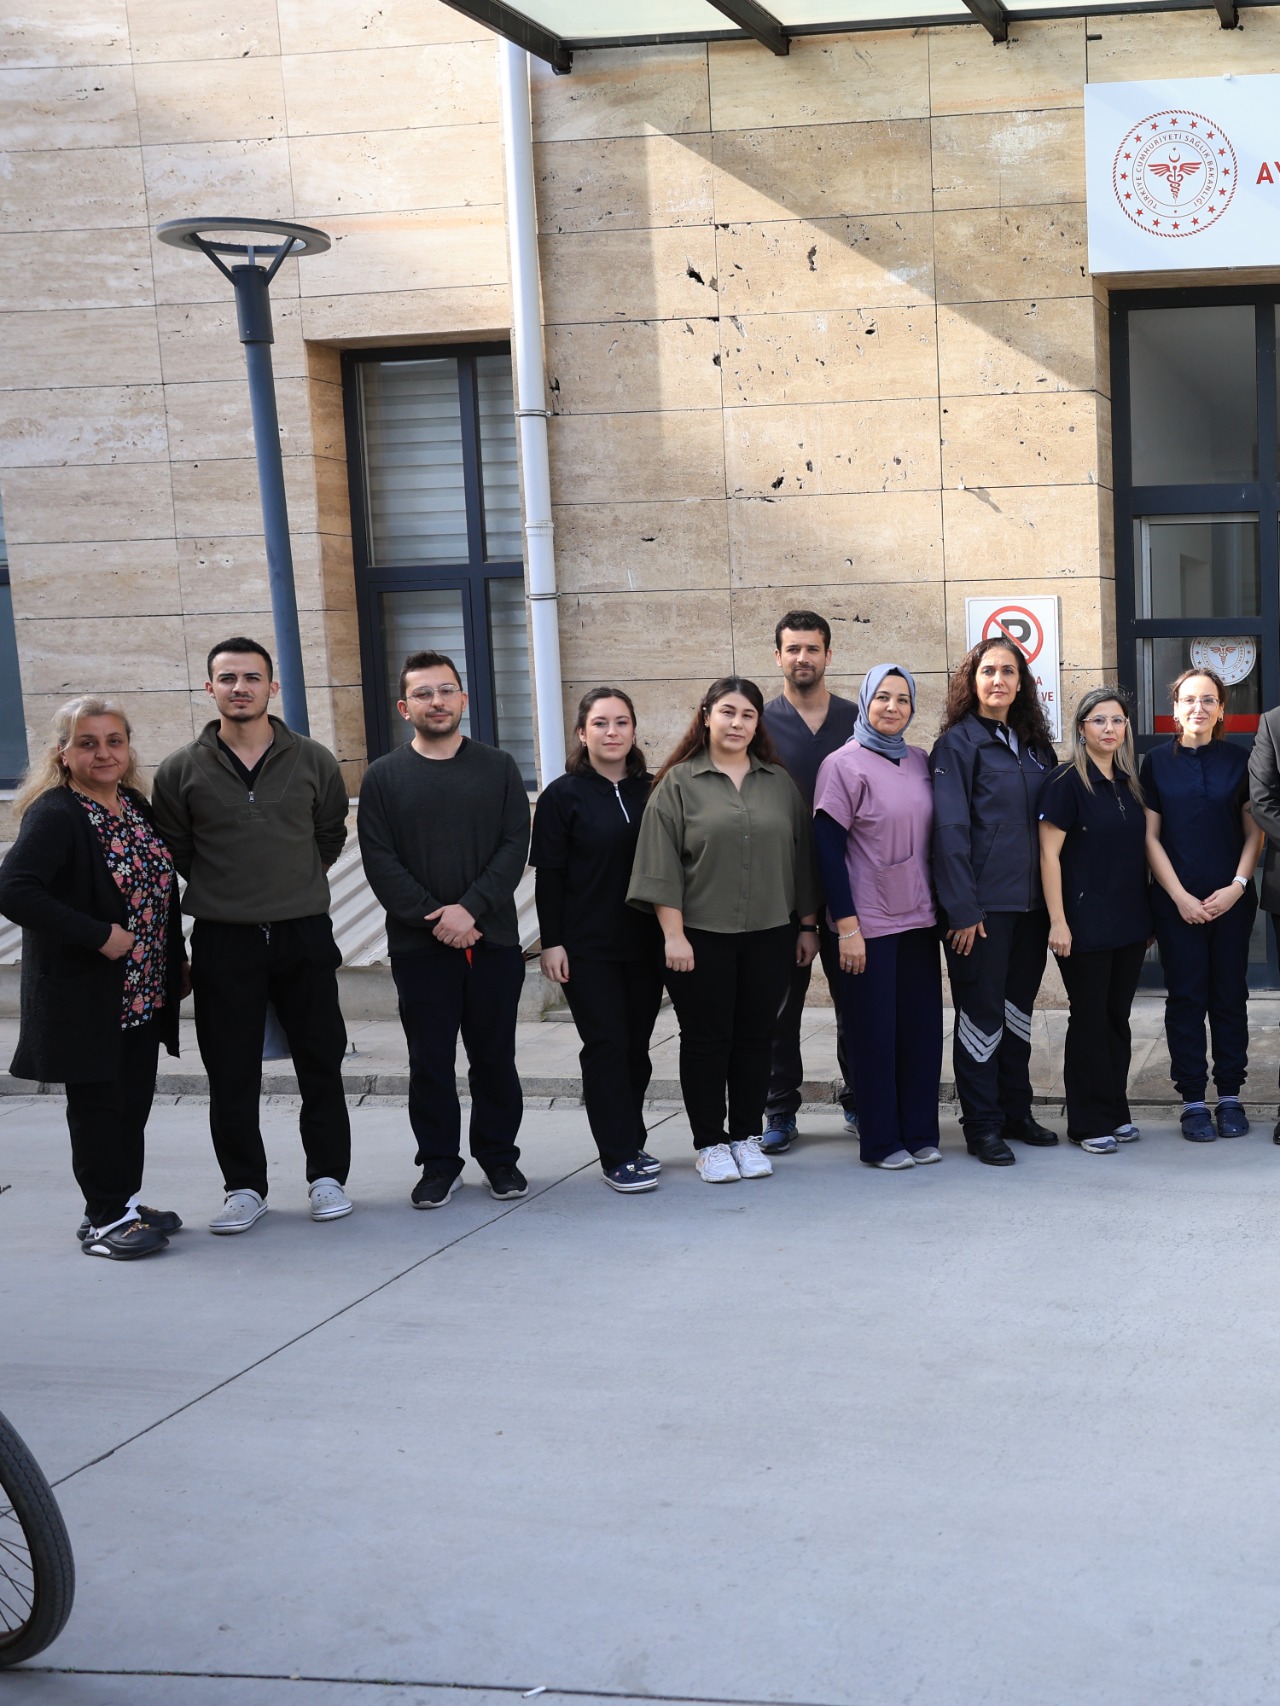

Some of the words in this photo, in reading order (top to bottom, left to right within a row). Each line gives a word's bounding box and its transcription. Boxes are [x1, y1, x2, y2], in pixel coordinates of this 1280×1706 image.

[1184, 135, 1211, 159] SAĞLIK
[1193, 160, 1215, 207] BAKANLIĞI
[1041, 691, 1054, 702] VE
